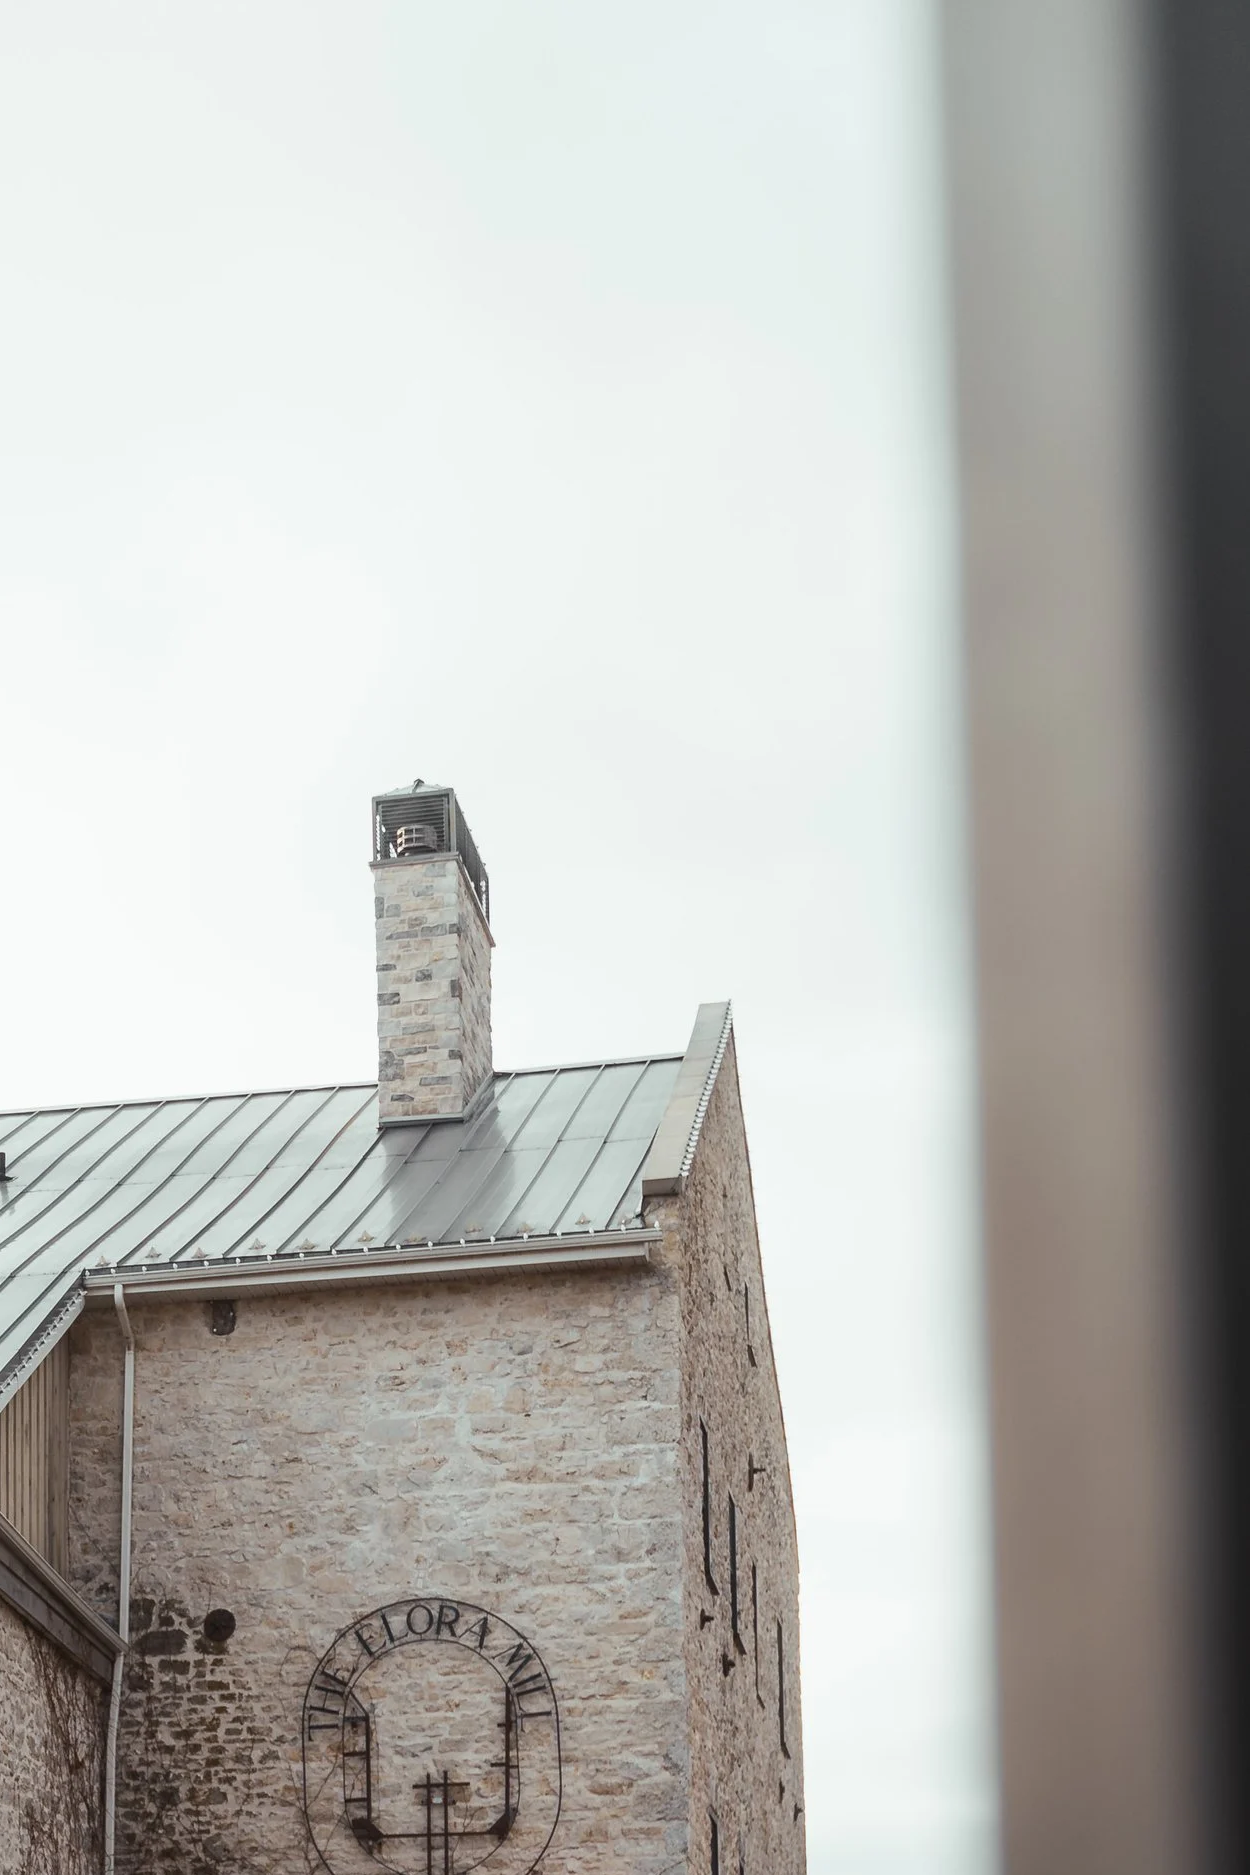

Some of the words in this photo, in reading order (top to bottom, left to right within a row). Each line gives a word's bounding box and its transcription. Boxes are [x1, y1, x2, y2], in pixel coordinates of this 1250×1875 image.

[308, 1657, 356, 1742] THE
[354, 1604, 489, 1656] ELORA
[491, 1642, 552, 1733] MILL
